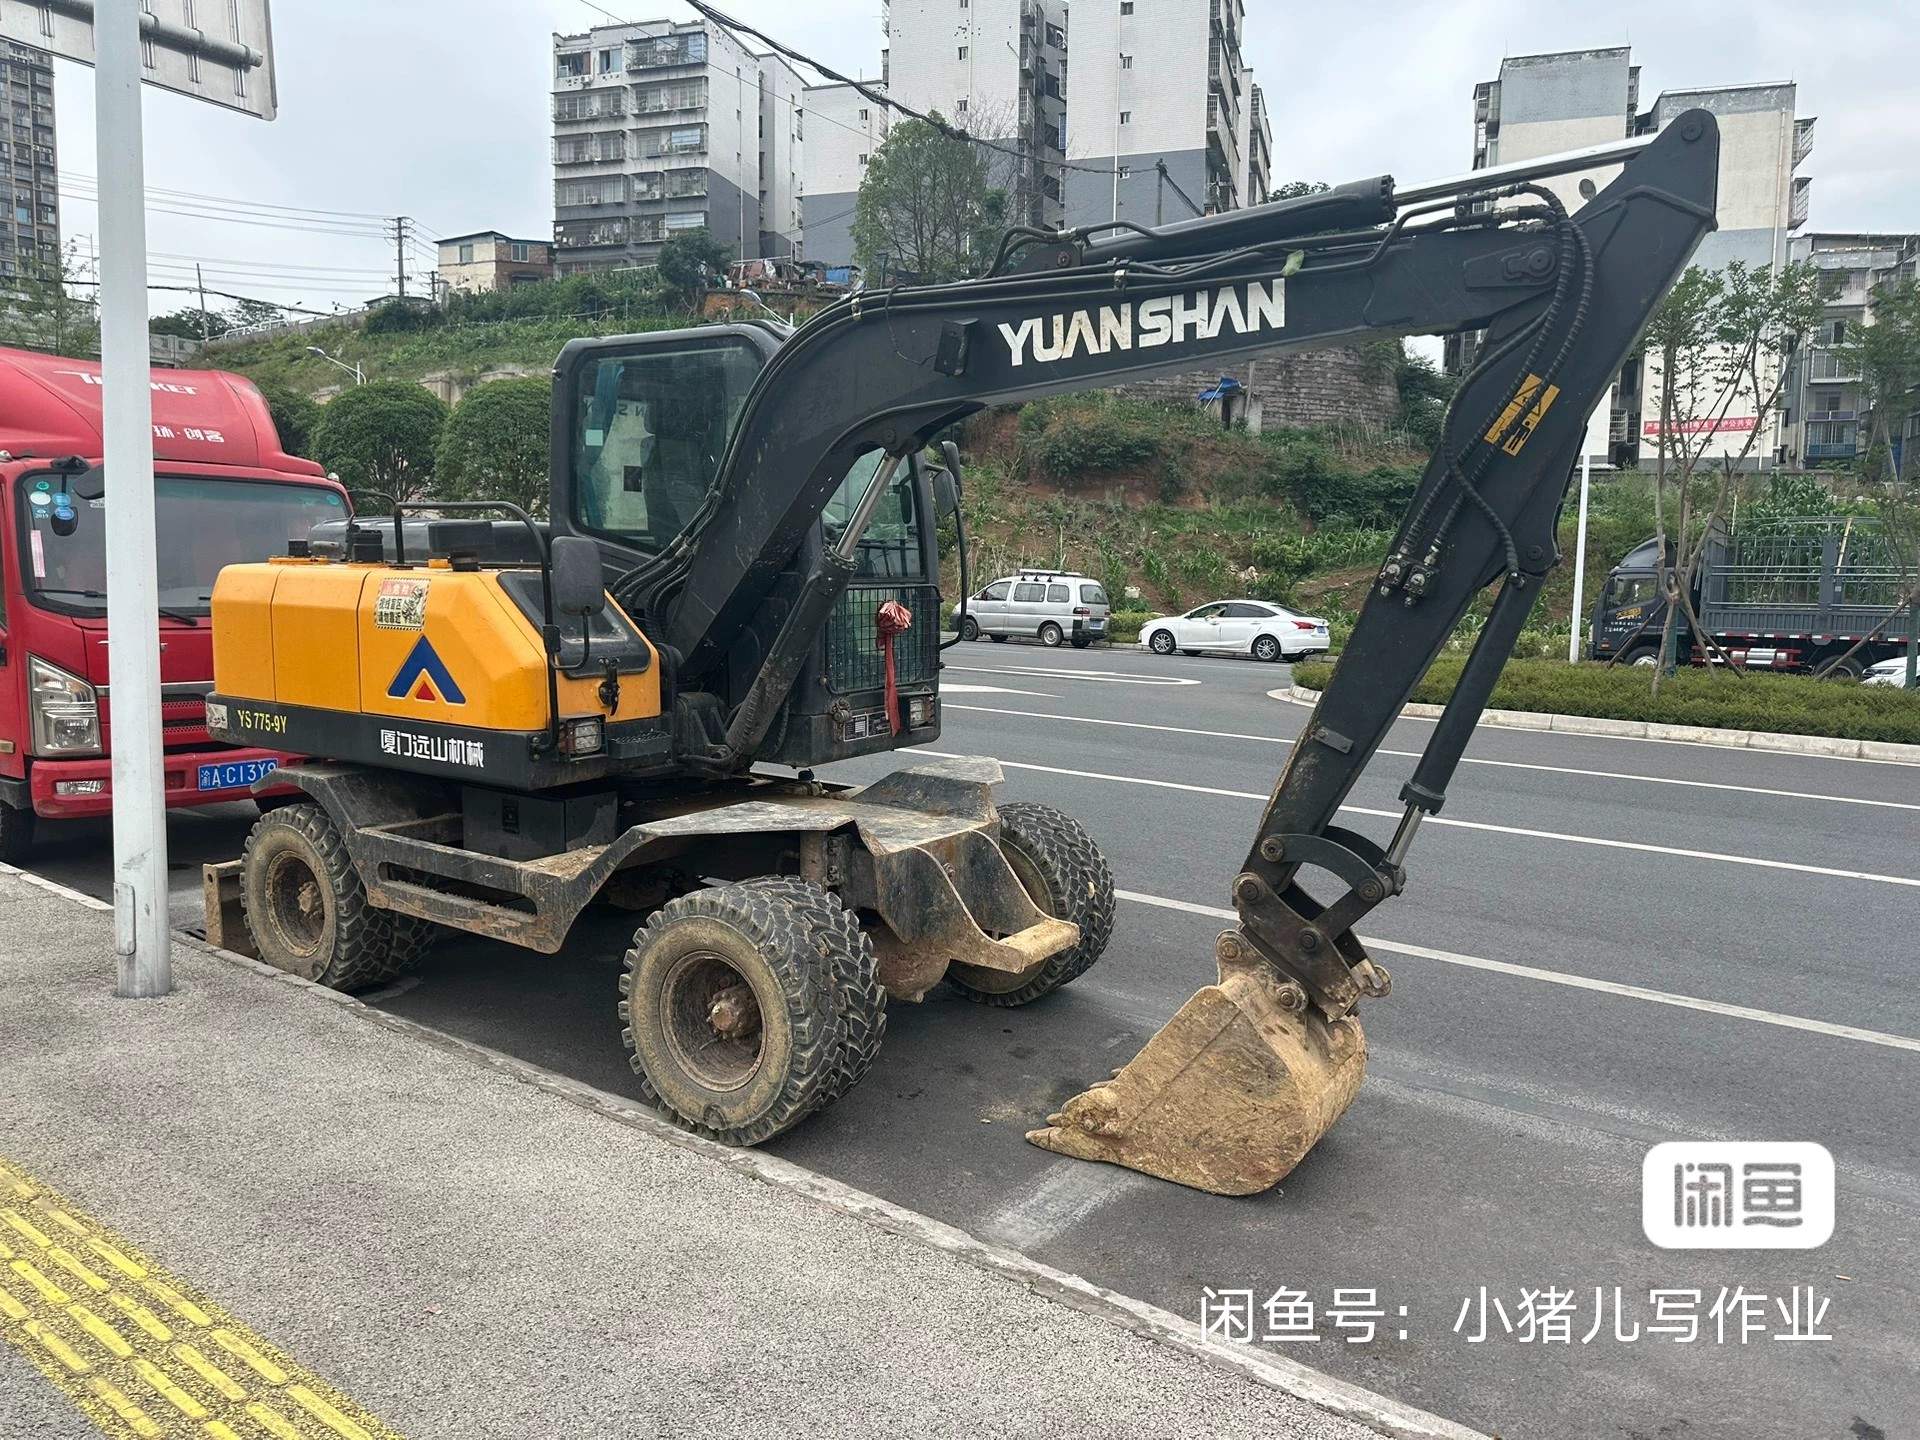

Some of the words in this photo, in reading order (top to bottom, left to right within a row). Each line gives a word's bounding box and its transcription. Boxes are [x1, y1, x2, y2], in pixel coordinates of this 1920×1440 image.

[380, 729, 484, 768] 厦门远山机械
